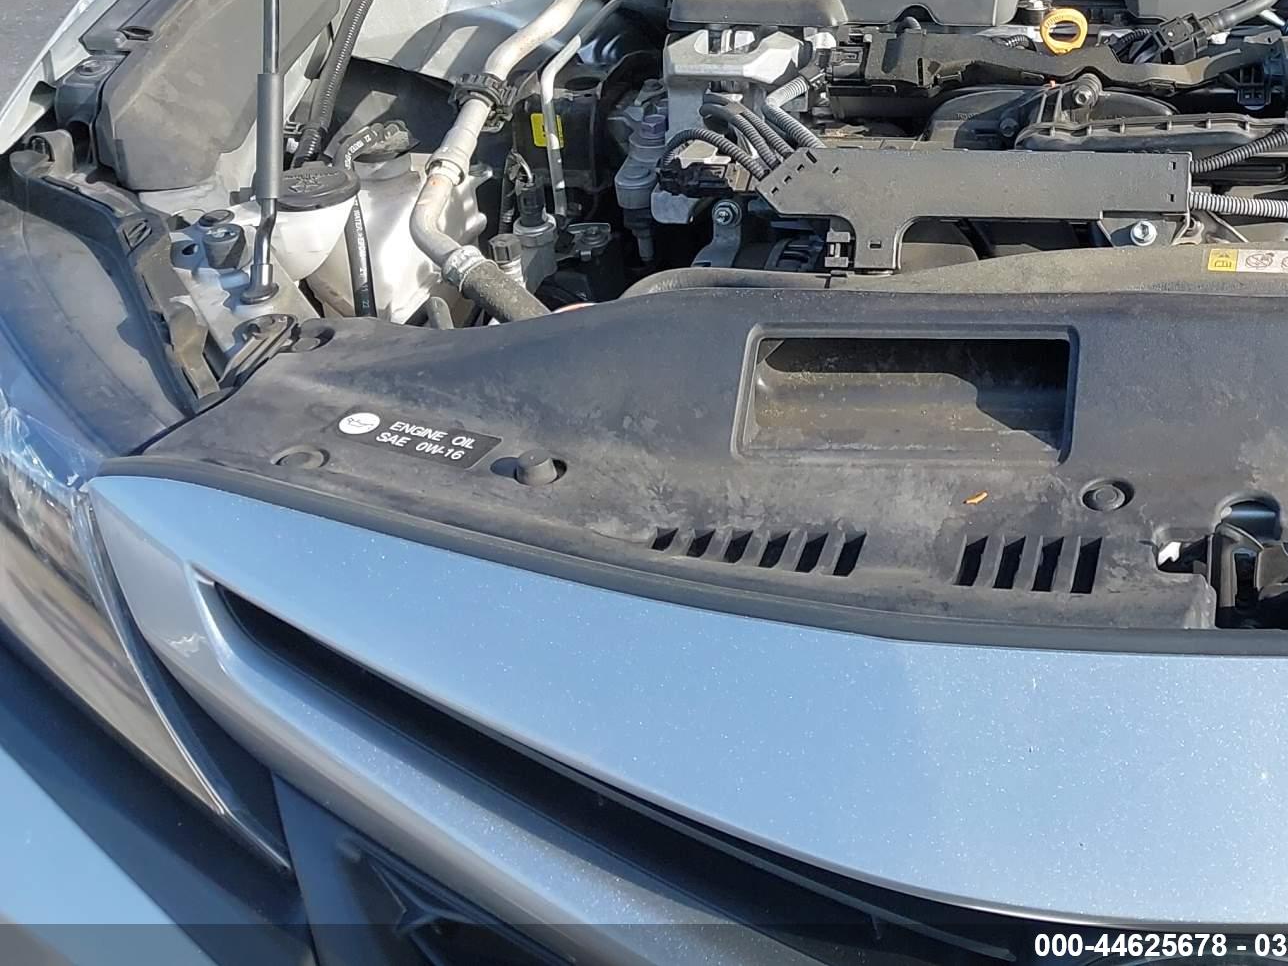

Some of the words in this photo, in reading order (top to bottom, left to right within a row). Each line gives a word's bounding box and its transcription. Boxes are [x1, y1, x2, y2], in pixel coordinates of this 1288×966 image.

[353, 209, 363, 232] WATER
[376, 432, 411, 447] SAE
[415, 442, 465, 460] 0W-16
[389, 421, 448, 441] ENGINE
[451, 436, 475, 449] OIL
